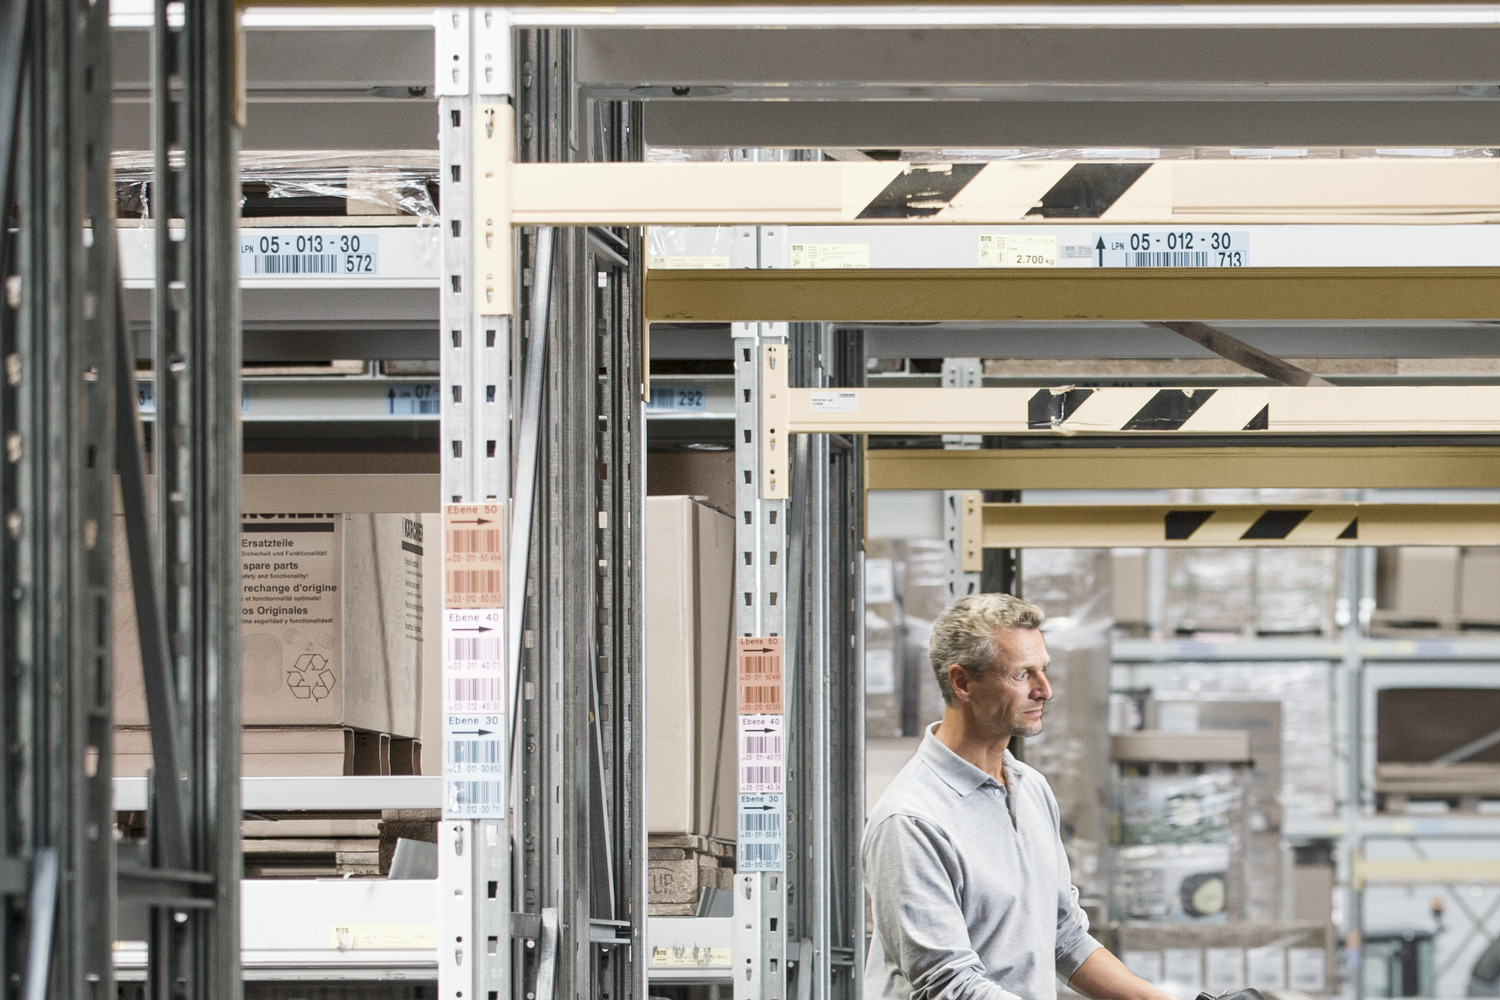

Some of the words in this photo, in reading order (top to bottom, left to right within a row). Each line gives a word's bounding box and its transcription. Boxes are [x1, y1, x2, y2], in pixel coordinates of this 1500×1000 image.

[241, 245, 254, 254] LPN
[260, 236, 280, 254] 05
[296, 235, 323, 252] 013
[340, 235, 360, 252] 30
[1112, 242, 1125, 250] LPN
[1130, 233, 1150, 250] 05
[1167, 232, 1194, 250] 012
[1211, 232, 1231, 250] 30
[346, 255, 373, 272] 572
[1016, 254, 1044, 264] 2.700
[1218, 252, 1242, 267] 713
[680, 391, 702, 406] 292
[448, 505, 478, 514] Ebene
[484, 505, 498, 514] 50
[242, 538, 294, 548] Ersatzteile
[243, 562, 270, 572] spare
[274, 562, 299, 572] parts
[244, 584, 290, 594] rechange
[293, 584, 337, 594] d'origine
[257, 606, 308, 616] Originales
[449, 613, 480, 622] Ebene
[486, 613, 500, 622] 40
[448, 716, 479, 725] Ebene
[486, 716, 499, 725] 30
[648, 874, 674, 894] UR
